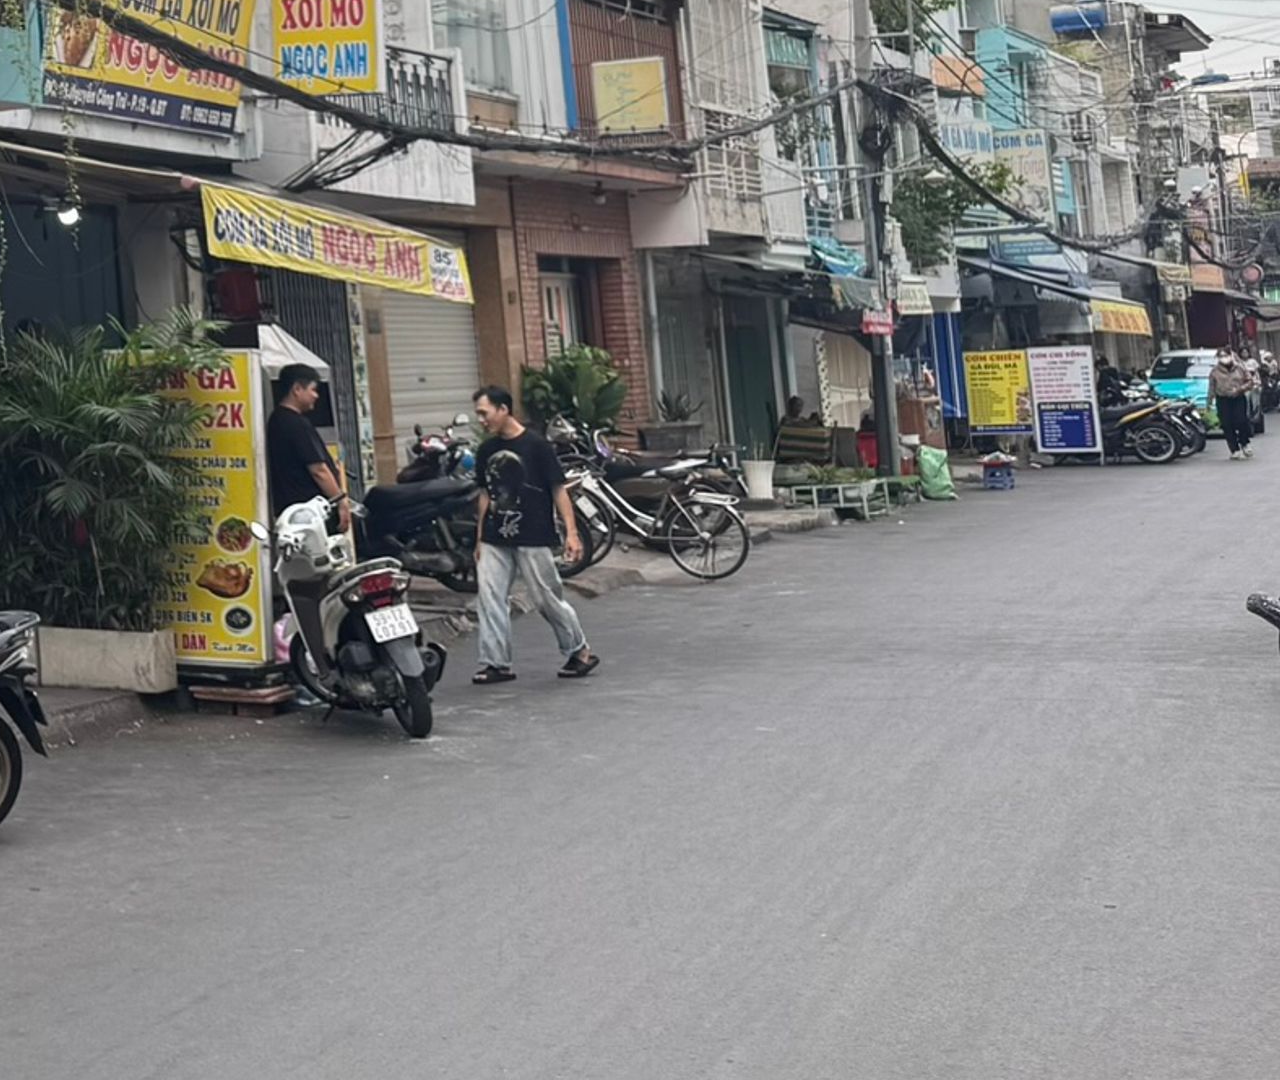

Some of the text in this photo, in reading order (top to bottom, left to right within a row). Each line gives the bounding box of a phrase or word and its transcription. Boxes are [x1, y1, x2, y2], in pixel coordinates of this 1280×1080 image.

[281, 42, 368, 86] NGỌC ANH
[321, 223, 377, 275] NGỌC
[384, 238, 423, 281] ANH
